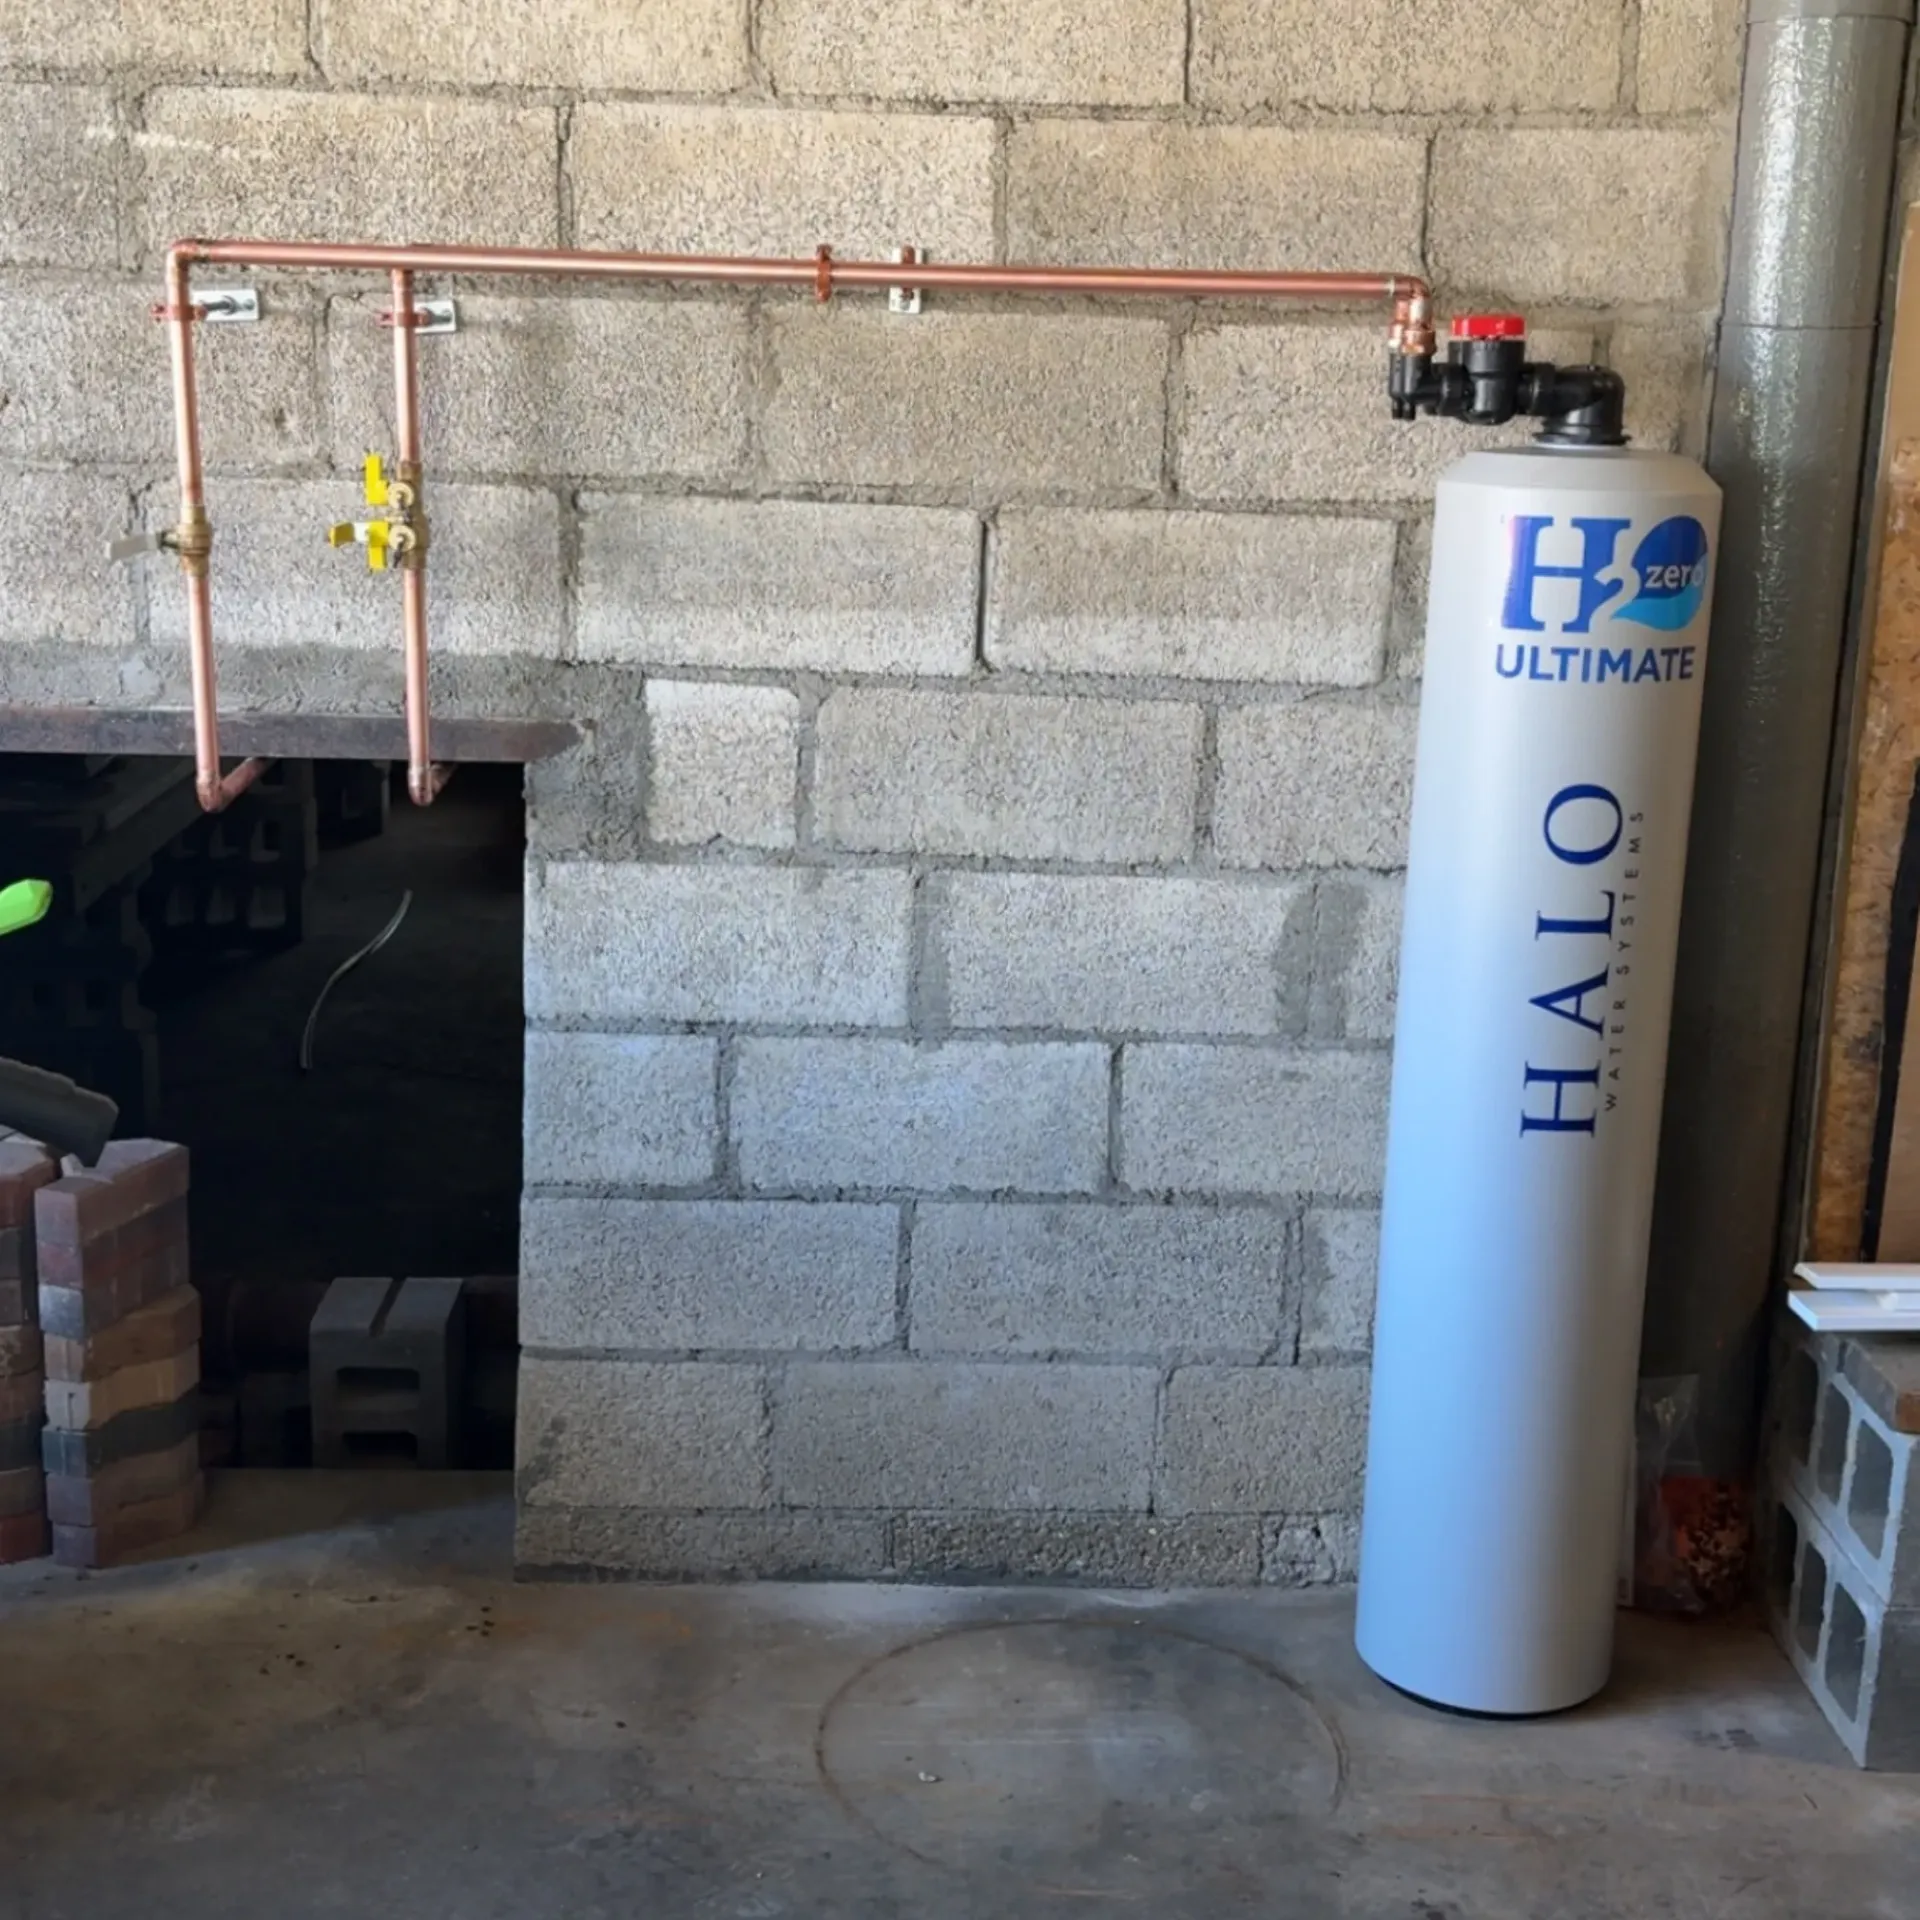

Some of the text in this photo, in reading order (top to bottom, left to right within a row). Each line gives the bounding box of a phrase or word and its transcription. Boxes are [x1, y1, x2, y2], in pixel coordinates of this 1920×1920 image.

[1645, 564, 1704, 589] zero
[1496, 643, 1694, 683] ULTIMATE
[1520, 783, 1623, 1138] HALO
[1604, 811, 1644, 1112] WATER SYSTEMS
